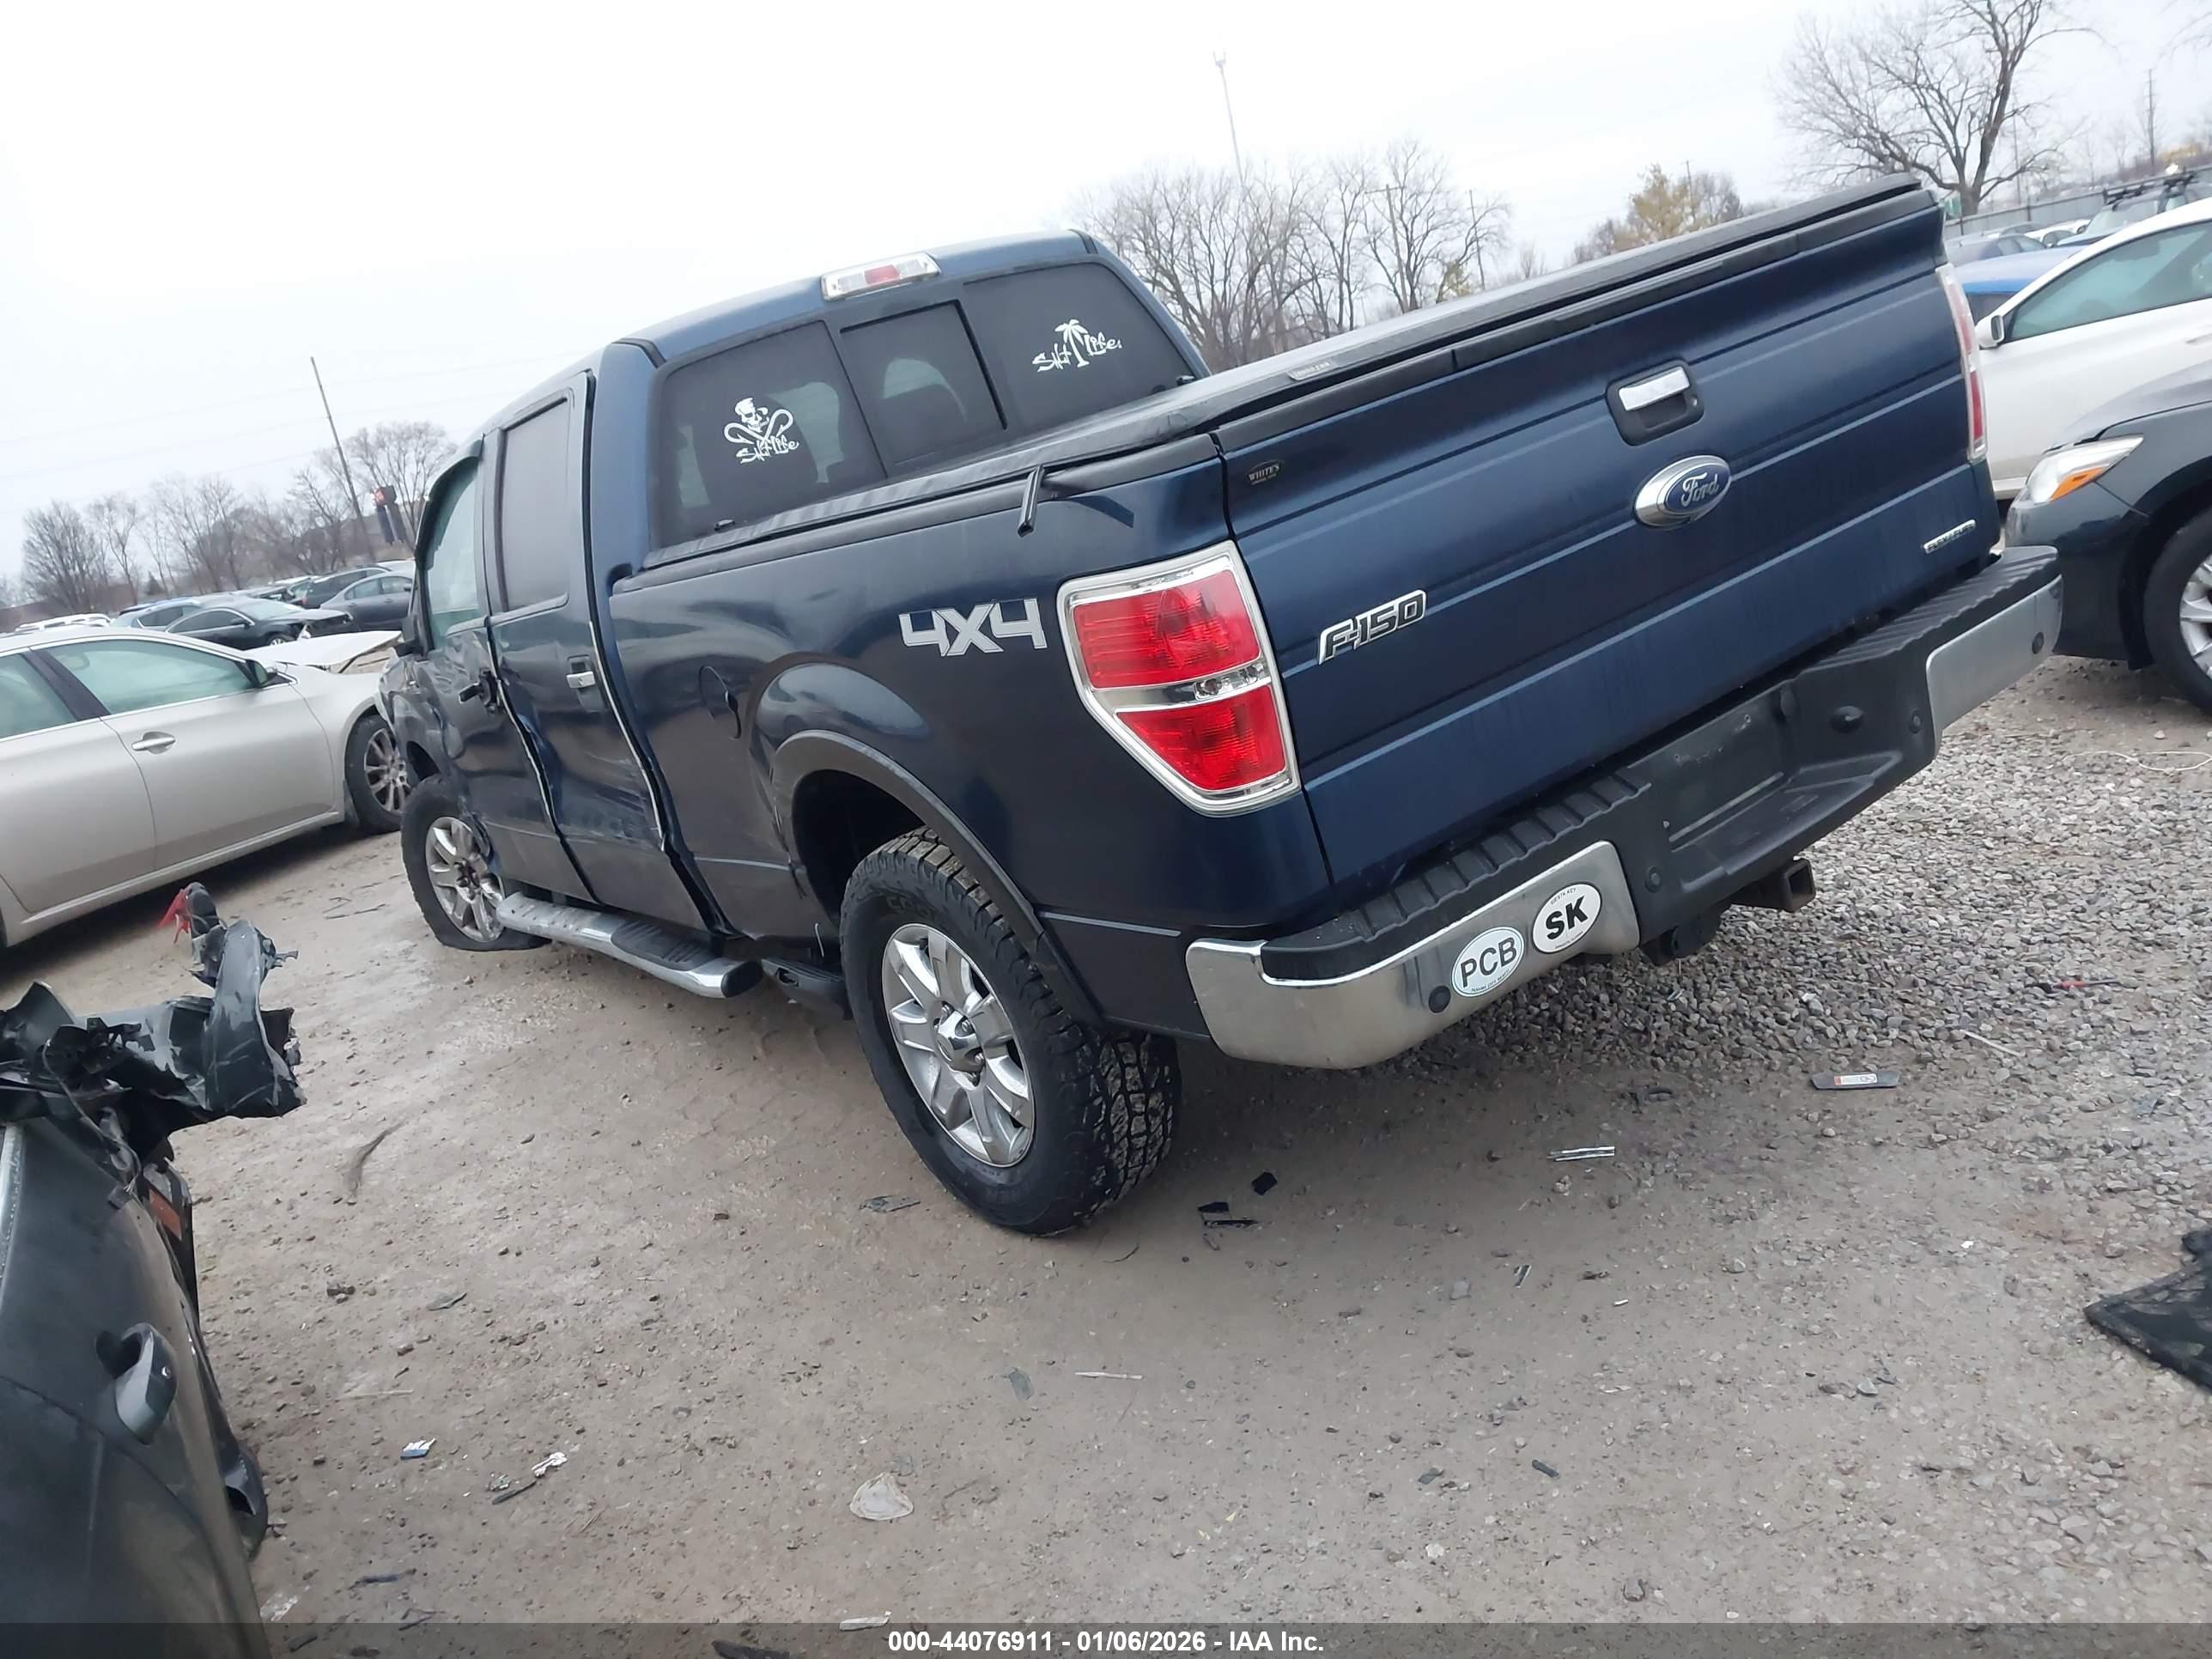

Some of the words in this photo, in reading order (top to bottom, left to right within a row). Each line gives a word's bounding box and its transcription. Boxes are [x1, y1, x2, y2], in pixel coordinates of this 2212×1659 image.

[1680, 471, 1720, 507] Ford
[1319, 589, 1426, 665] F-150
[1546, 895, 1589, 939] SK
[1460, 937, 1517, 988] PCB
